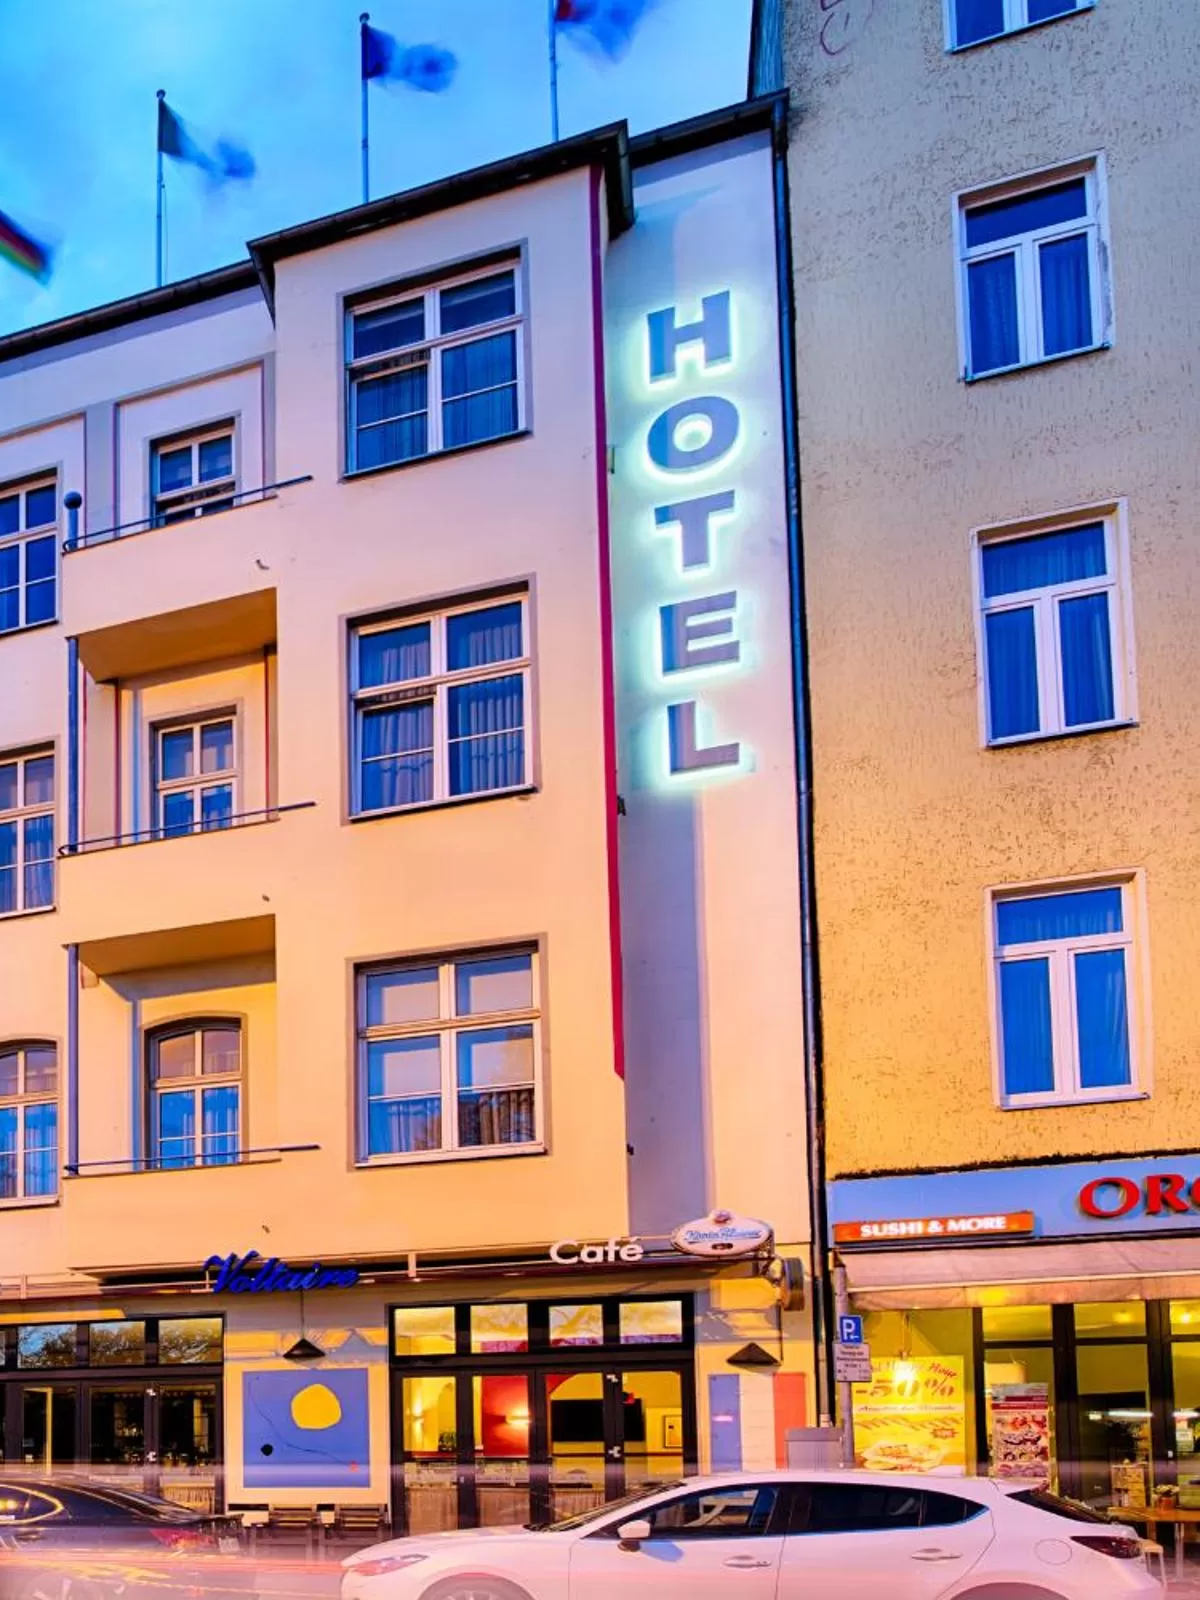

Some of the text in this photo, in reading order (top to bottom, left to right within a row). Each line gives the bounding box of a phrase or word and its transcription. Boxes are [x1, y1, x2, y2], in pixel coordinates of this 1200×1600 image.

[646, 289, 741, 776] HOTEL
[1079, 1172, 1200, 1218] OR
[860, 1215, 1007, 1238] SUSHI & MORE
[550, 1235, 644, 1265] Café
[202, 1250, 361, 1294] Voltaire
[842, 1318, 855, 1341] P
